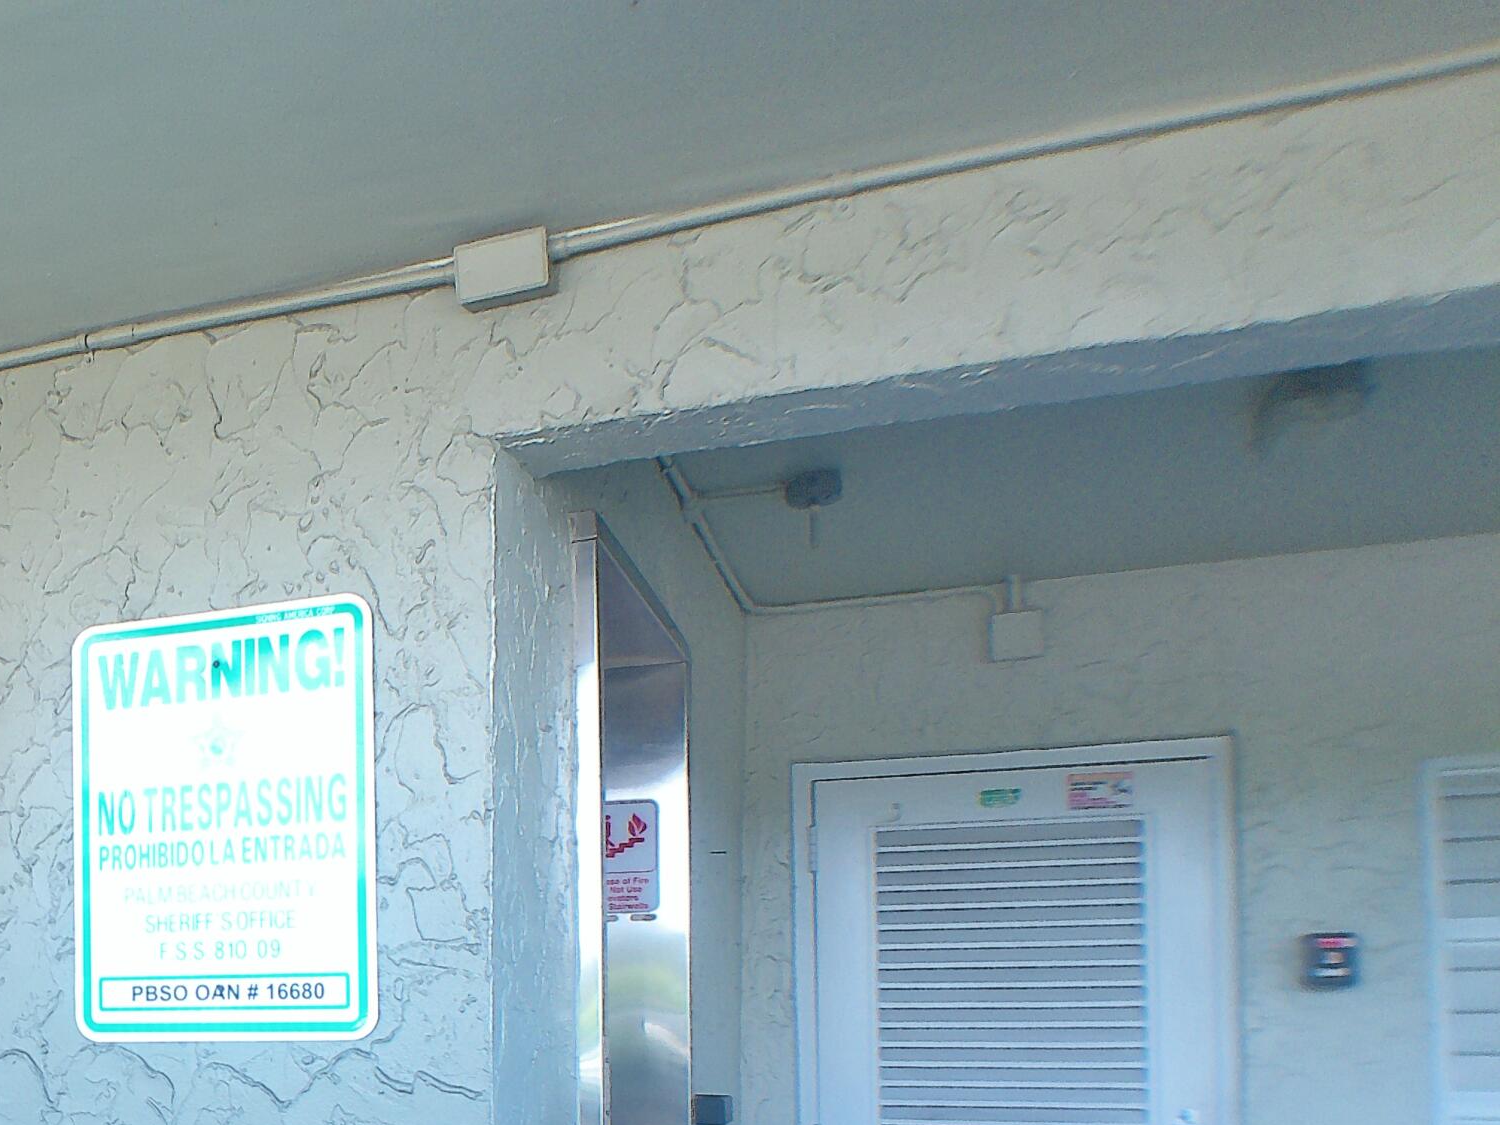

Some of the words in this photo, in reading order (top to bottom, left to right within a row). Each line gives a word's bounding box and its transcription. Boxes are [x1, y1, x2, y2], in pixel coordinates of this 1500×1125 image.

[98, 627, 345, 711] WARNING!
[98, 790, 135, 836] NO
[143, 773, 348, 833] TRESPASSING
[99, 840, 204, 871] PROHIBIDO
[210, 838, 235, 865] LA
[242, 832, 346, 864] ENTRADA
[124, 885, 172, 905] PALM
[177, 883, 235, 903] BEACH
[240, 879, 316, 899] COUNTY
[236, 910, 296, 931] OFFICE
[132, 985, 188, 1002] PBSO
[247, 983, 259, 1000] #
[267, 982, 325, 1000] 16680
